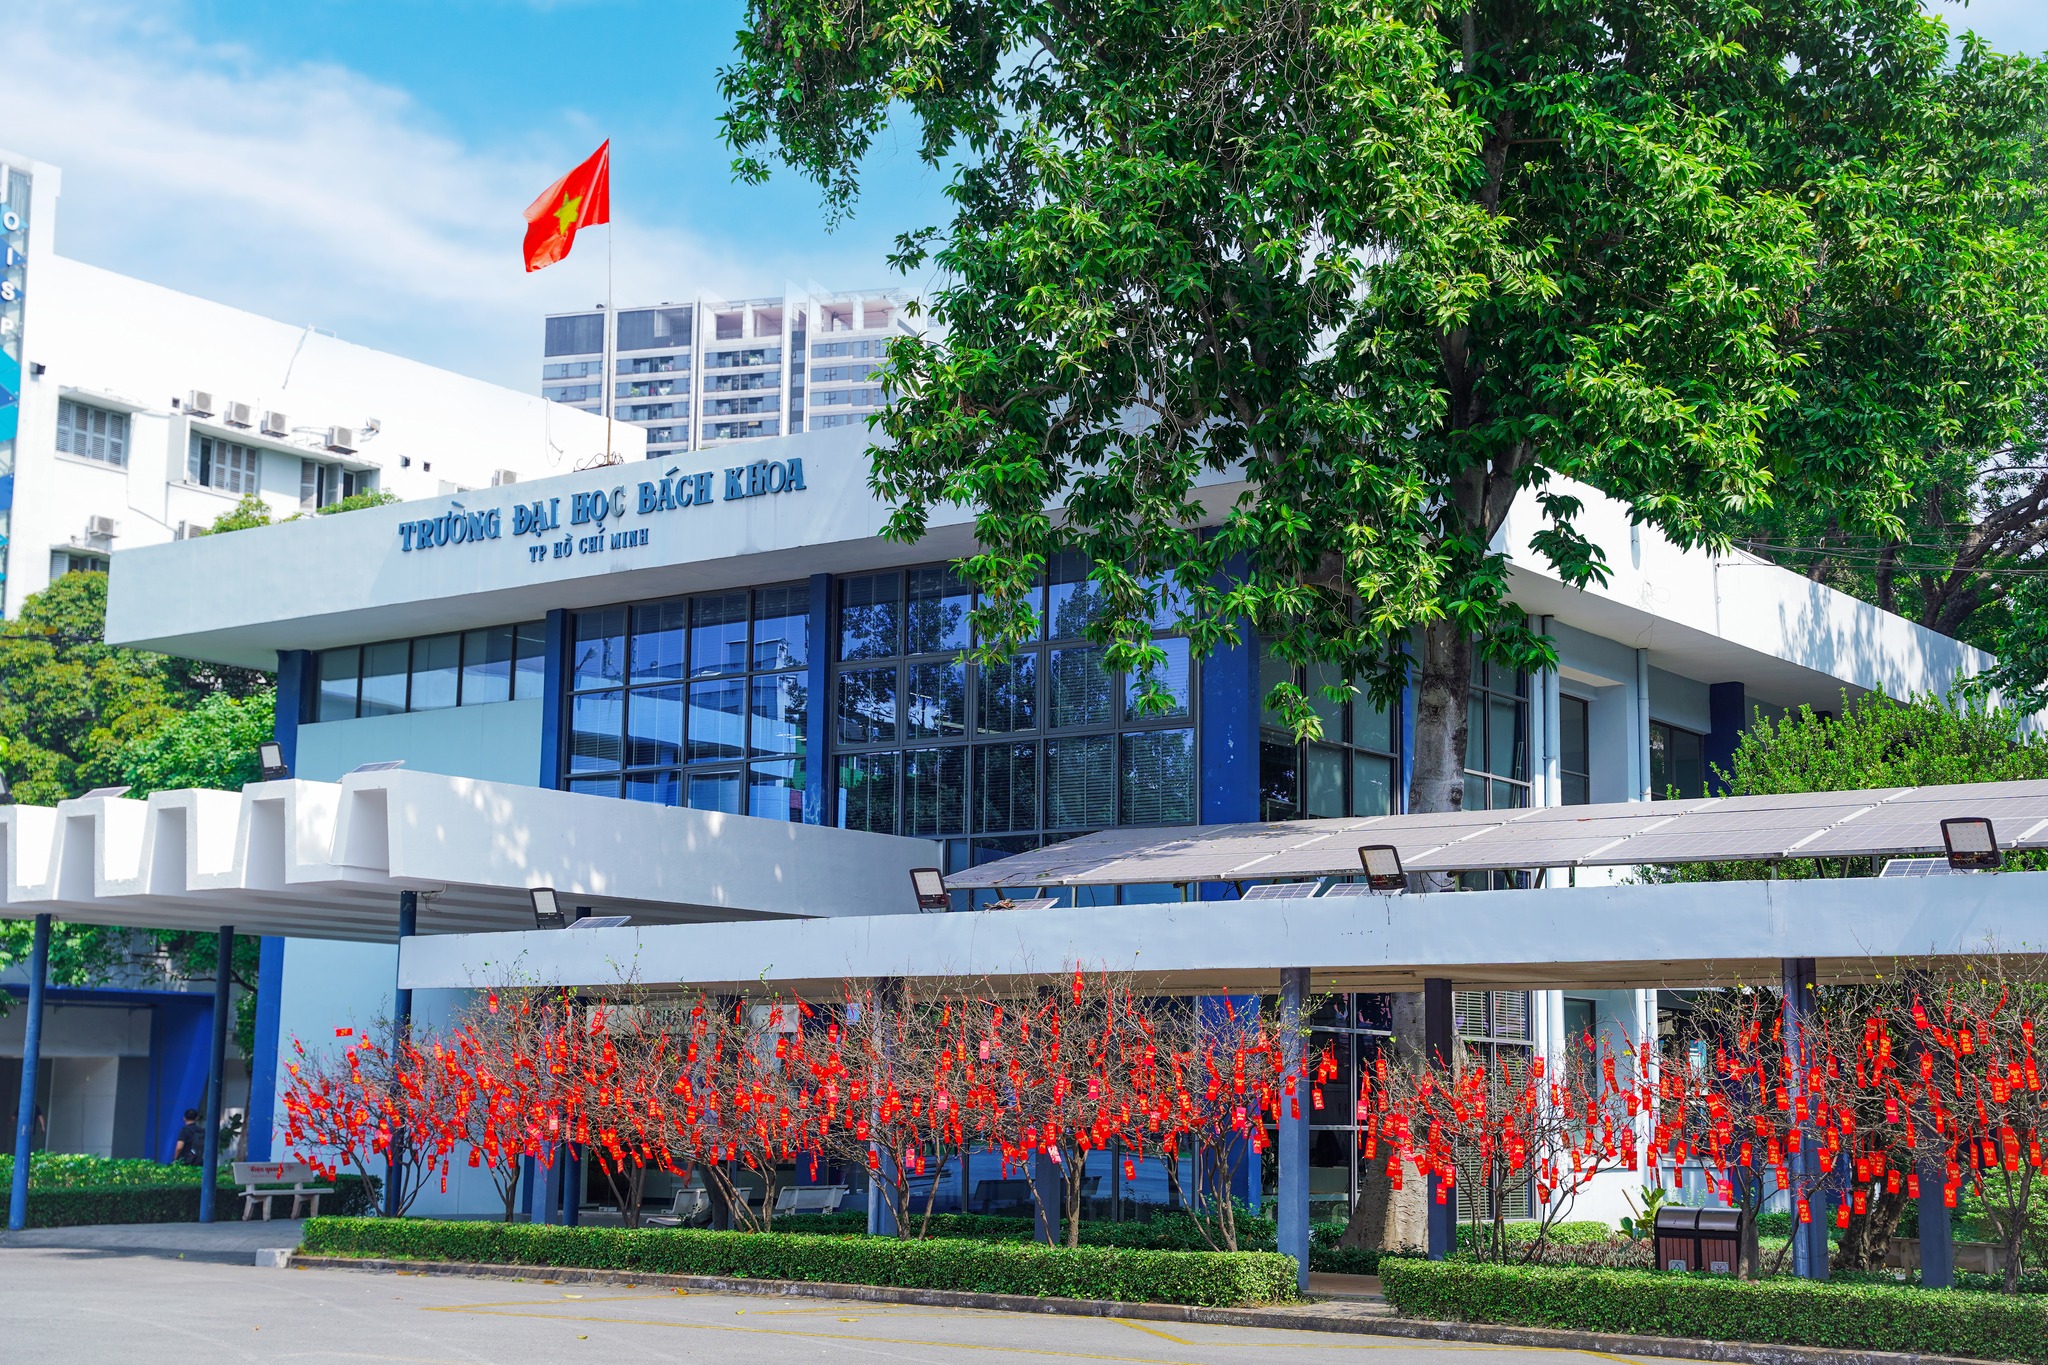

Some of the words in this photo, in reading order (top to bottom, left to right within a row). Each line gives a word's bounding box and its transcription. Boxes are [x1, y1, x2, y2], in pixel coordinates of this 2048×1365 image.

[399, 501, 502, 551] TRƯỜNG
[512, 498, 561, 537] ĐẠI
[571, 485, 627, 527] HỌC
[637, 466, 714, 515] BÁCH
[723, 457, 806, 501] KHOA
[529, 544, 547, 562] TP
[553, 533, 573, 558] HỒ
[578, 527, 605, 554] CHÍ
[609, 527, 649, 550] MINH
